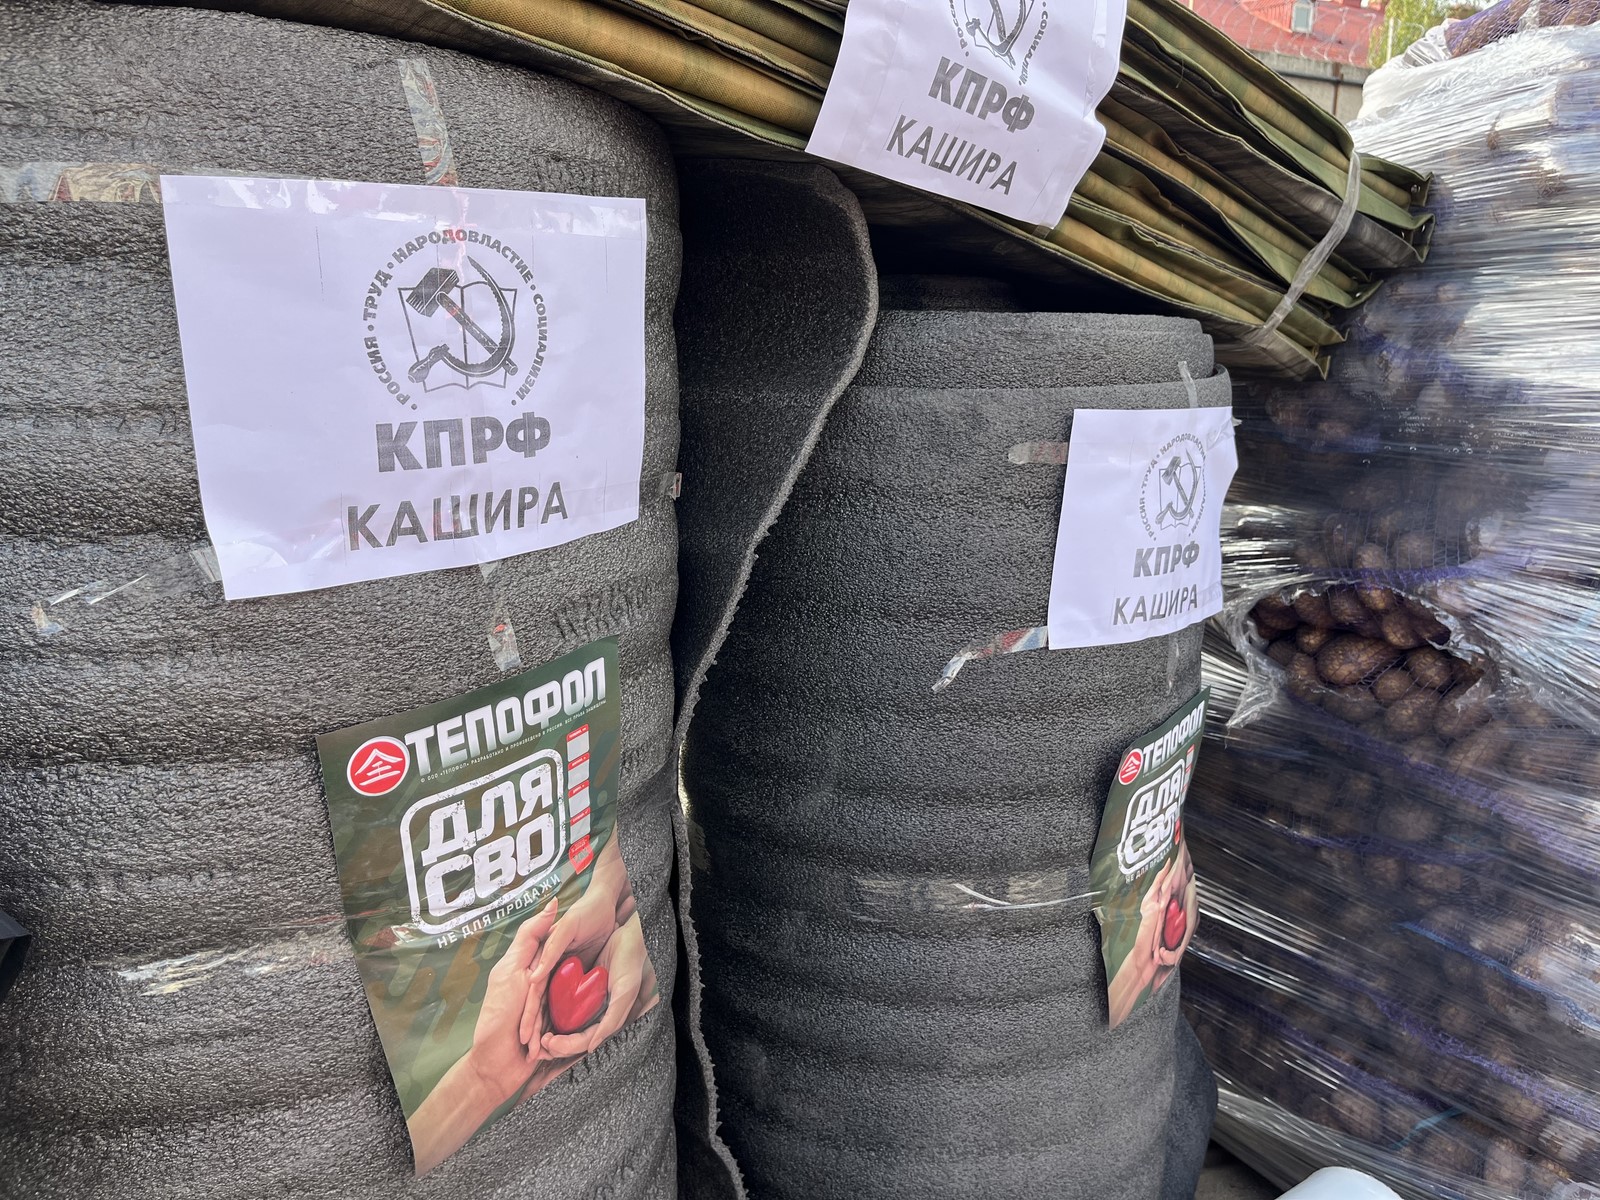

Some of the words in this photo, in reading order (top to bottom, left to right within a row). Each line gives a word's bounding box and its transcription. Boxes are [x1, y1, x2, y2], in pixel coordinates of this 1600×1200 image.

[928, 56, 1036, 133] КПРФ
[885, 114, 1019, 196] КАШИРА
[391, 228, 534, 284] НАРОДОВЛАСТИЕ
[362, 268, 393, 322] ТРУД
[362, 335, 411, 406] РОССИЯ
[515, 293, 548, 401] СОЦИАЛИЗМ
[375, 411, 551, 473] КПРФ
[347, 480, 569, 551] КАШИРА
[1133, 540, 1200, 578] КПРФ
[1112, 583, 1198, 626] КАШИРА
[404, 656, 607, 777] ТЕПОФОЛ
[1142, 700, 1206, 773] ТЕПОФОЛ
[421, 763, 553, 867] ДЛЯ
[1130, 768, 1182, 831] ДЛЯ
[424, 812, 555, 918] СВО
[437, 929, 461, 950] НЕ
[462, 914, 492, 940] ДЛЯ
[496, 873, 562, 926] ПРОДАЖИ
